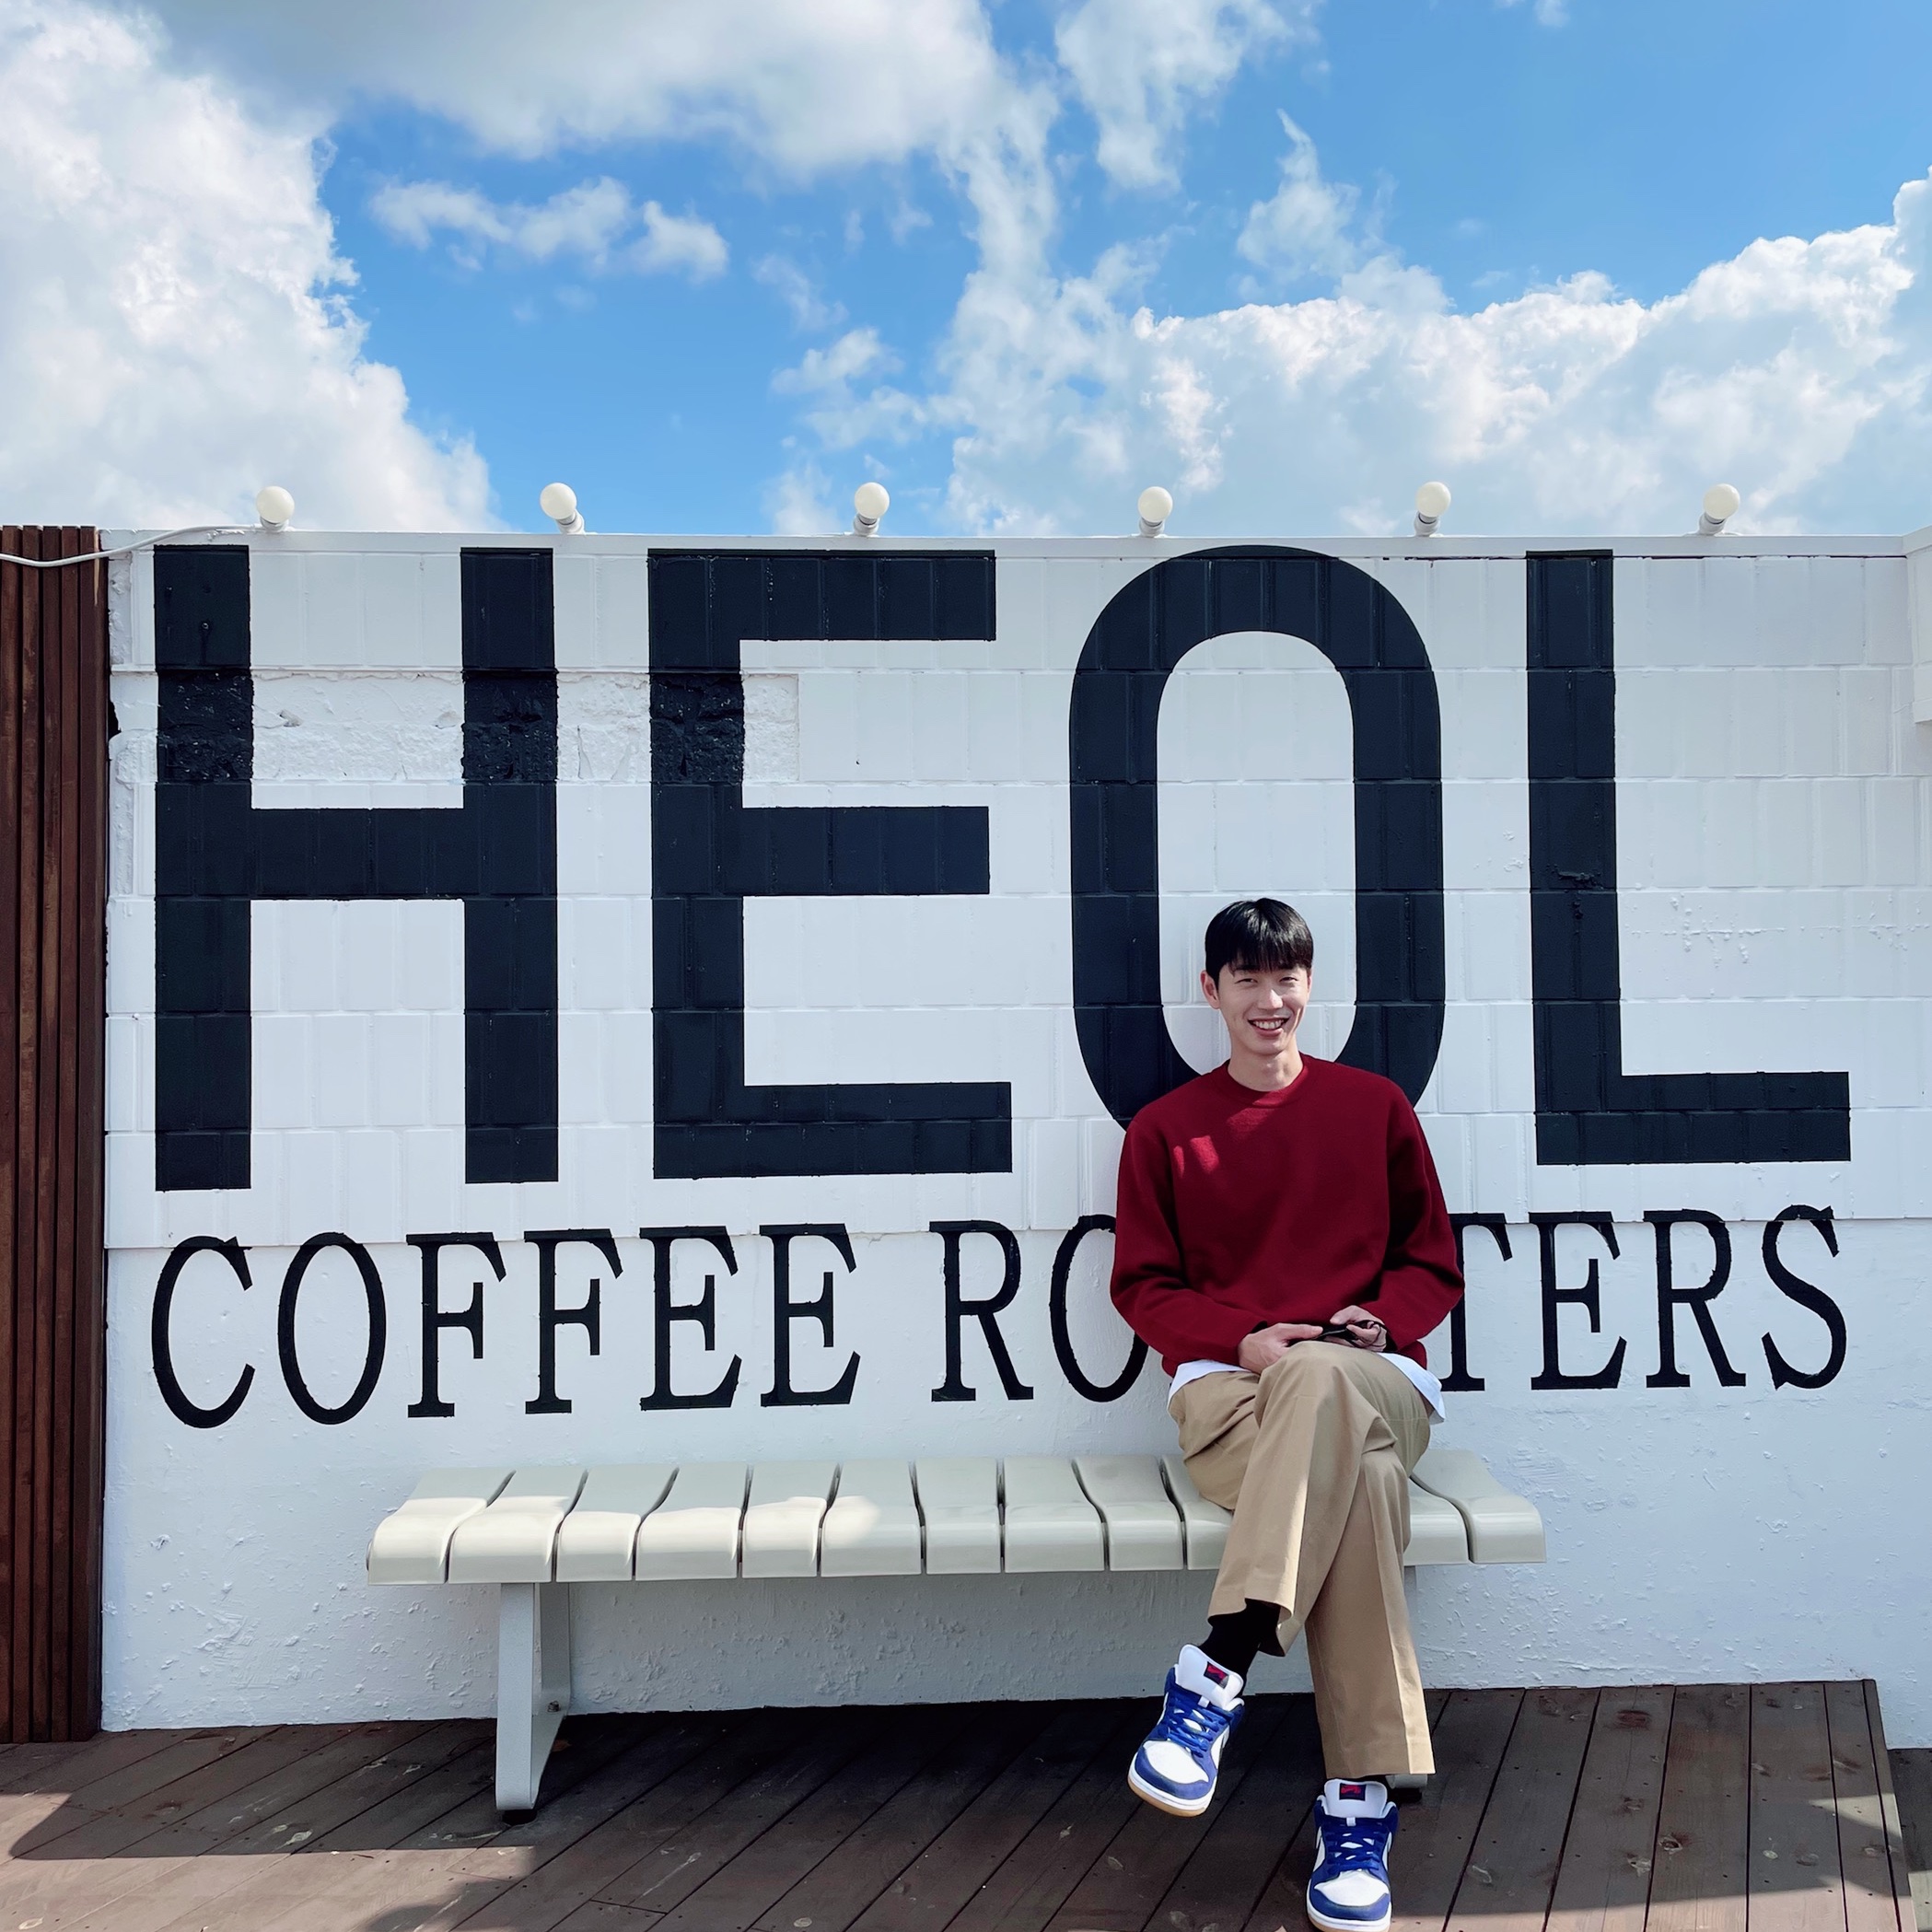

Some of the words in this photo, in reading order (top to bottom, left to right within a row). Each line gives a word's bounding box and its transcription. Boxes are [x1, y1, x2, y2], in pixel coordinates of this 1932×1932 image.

[153, 543, 1852, 1191] HEOL
[152, 1224, 861, 1429] COFFEE
[929, 1205, 1847, 1403] ROTERS
